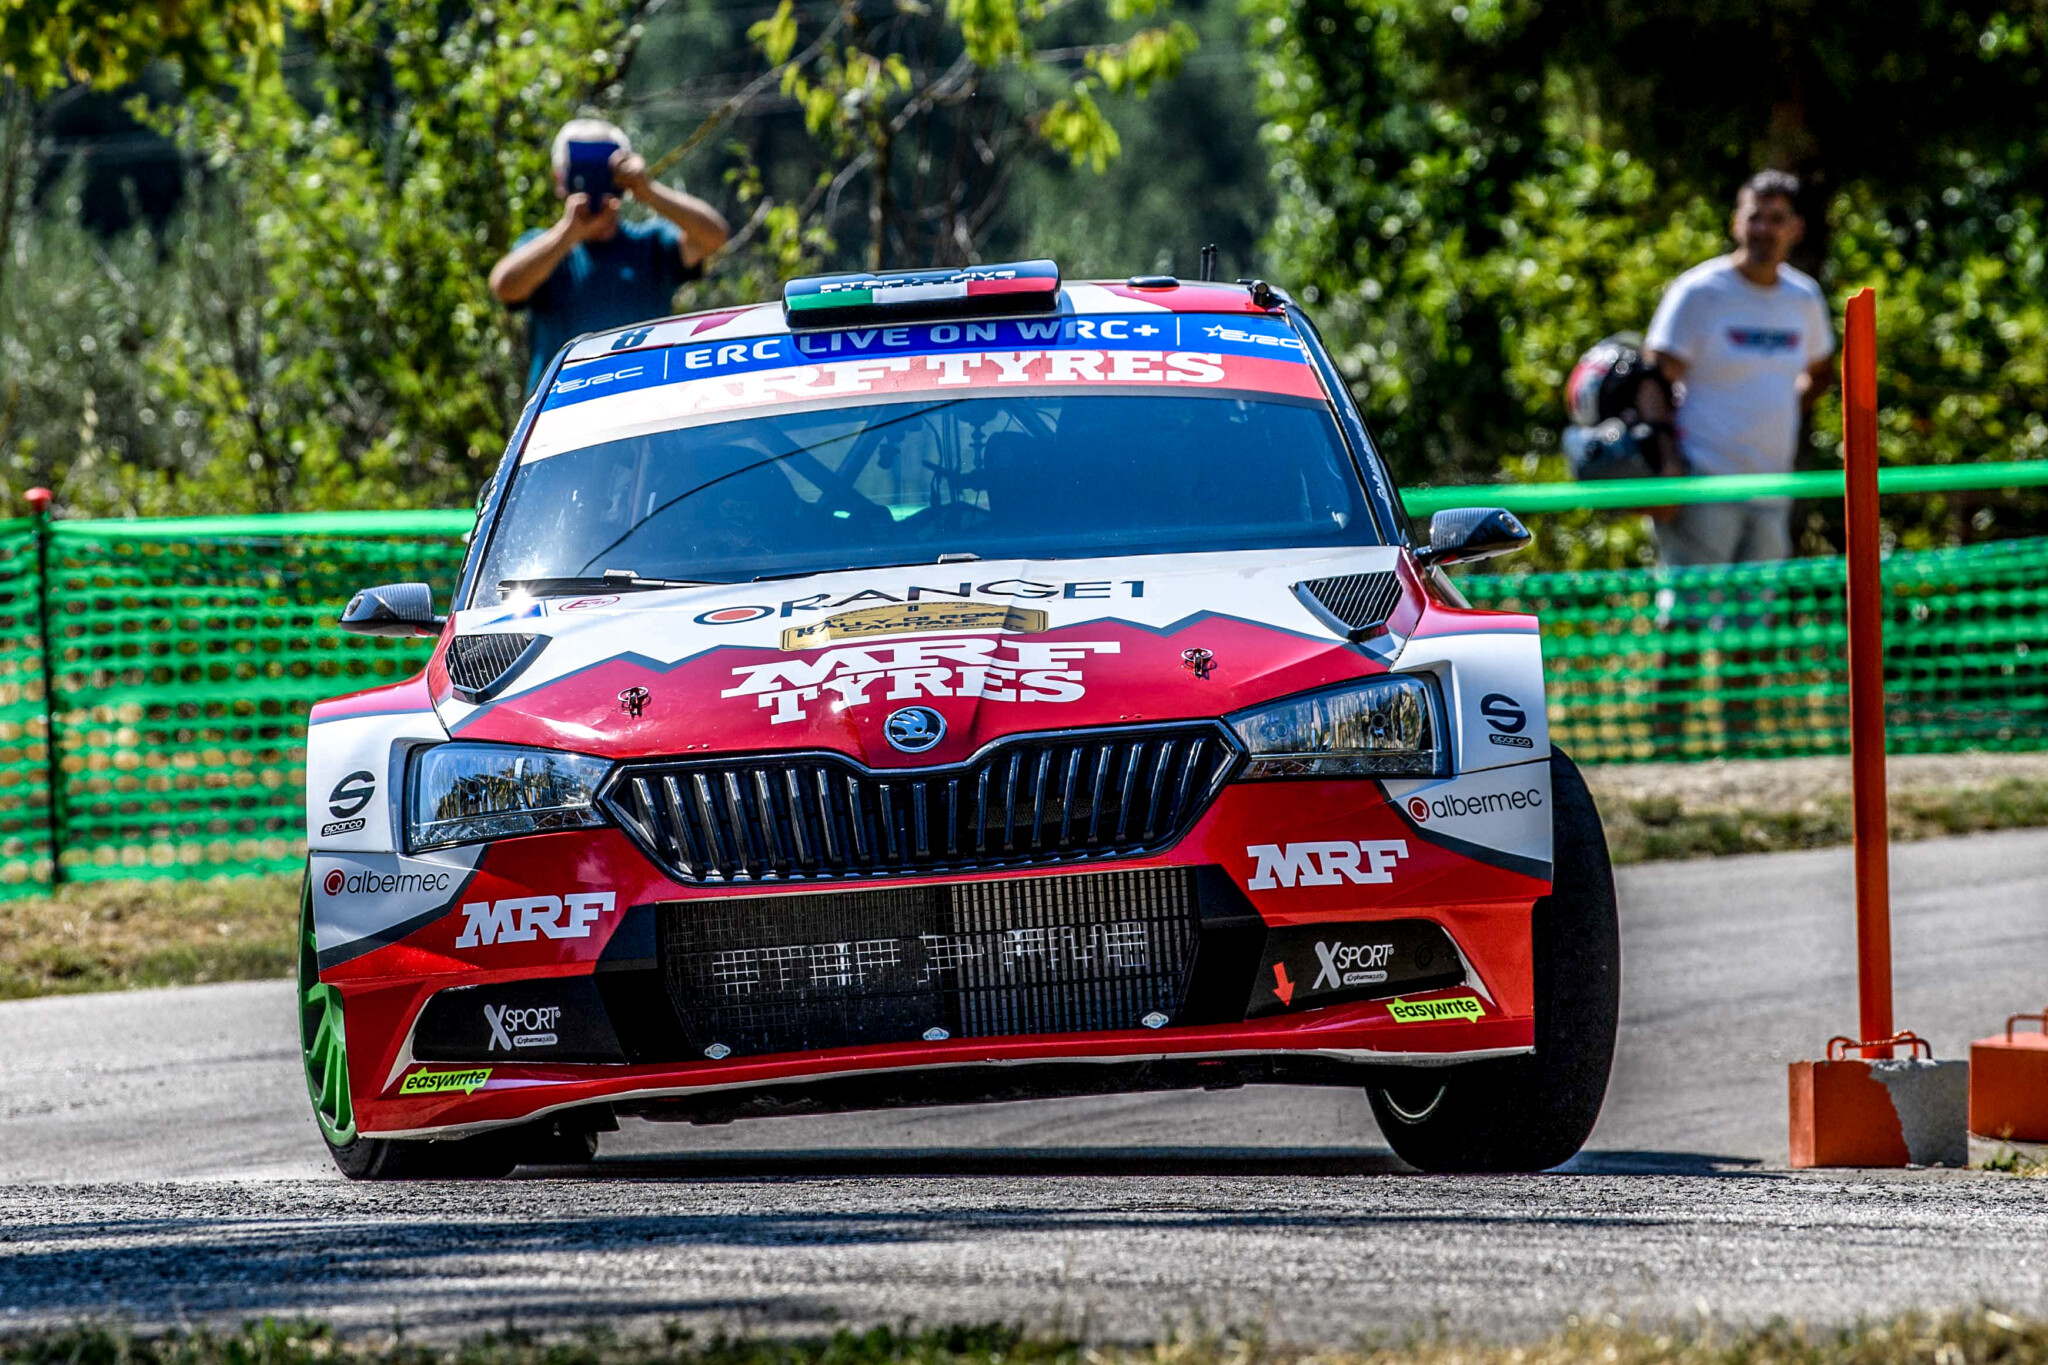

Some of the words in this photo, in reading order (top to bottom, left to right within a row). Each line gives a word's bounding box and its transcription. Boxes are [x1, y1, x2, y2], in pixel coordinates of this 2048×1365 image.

[685, 340, 780, 369] ERC
[800, 326, 910, 354] LIVE
[929, 322, 996, 345] ON
[1016, 319, 1160, 341] WRC+
[926, 350, 1225, 385] TYRES
[721, 639, 1121, 699] MRF
[758, 666, 1086, 725] TYRES
[1432, 788, 1543, 818] albermec
[322, 819, 364, 836] sparco
[346, 870, 449, 895] albermec
[1247, 839, 1409, 891] MRF
[455, 891, 616, 949] MRF
[1393, 999, 1479, 1020] easywrite
[406, 1070, 487, 1092] easywrite
